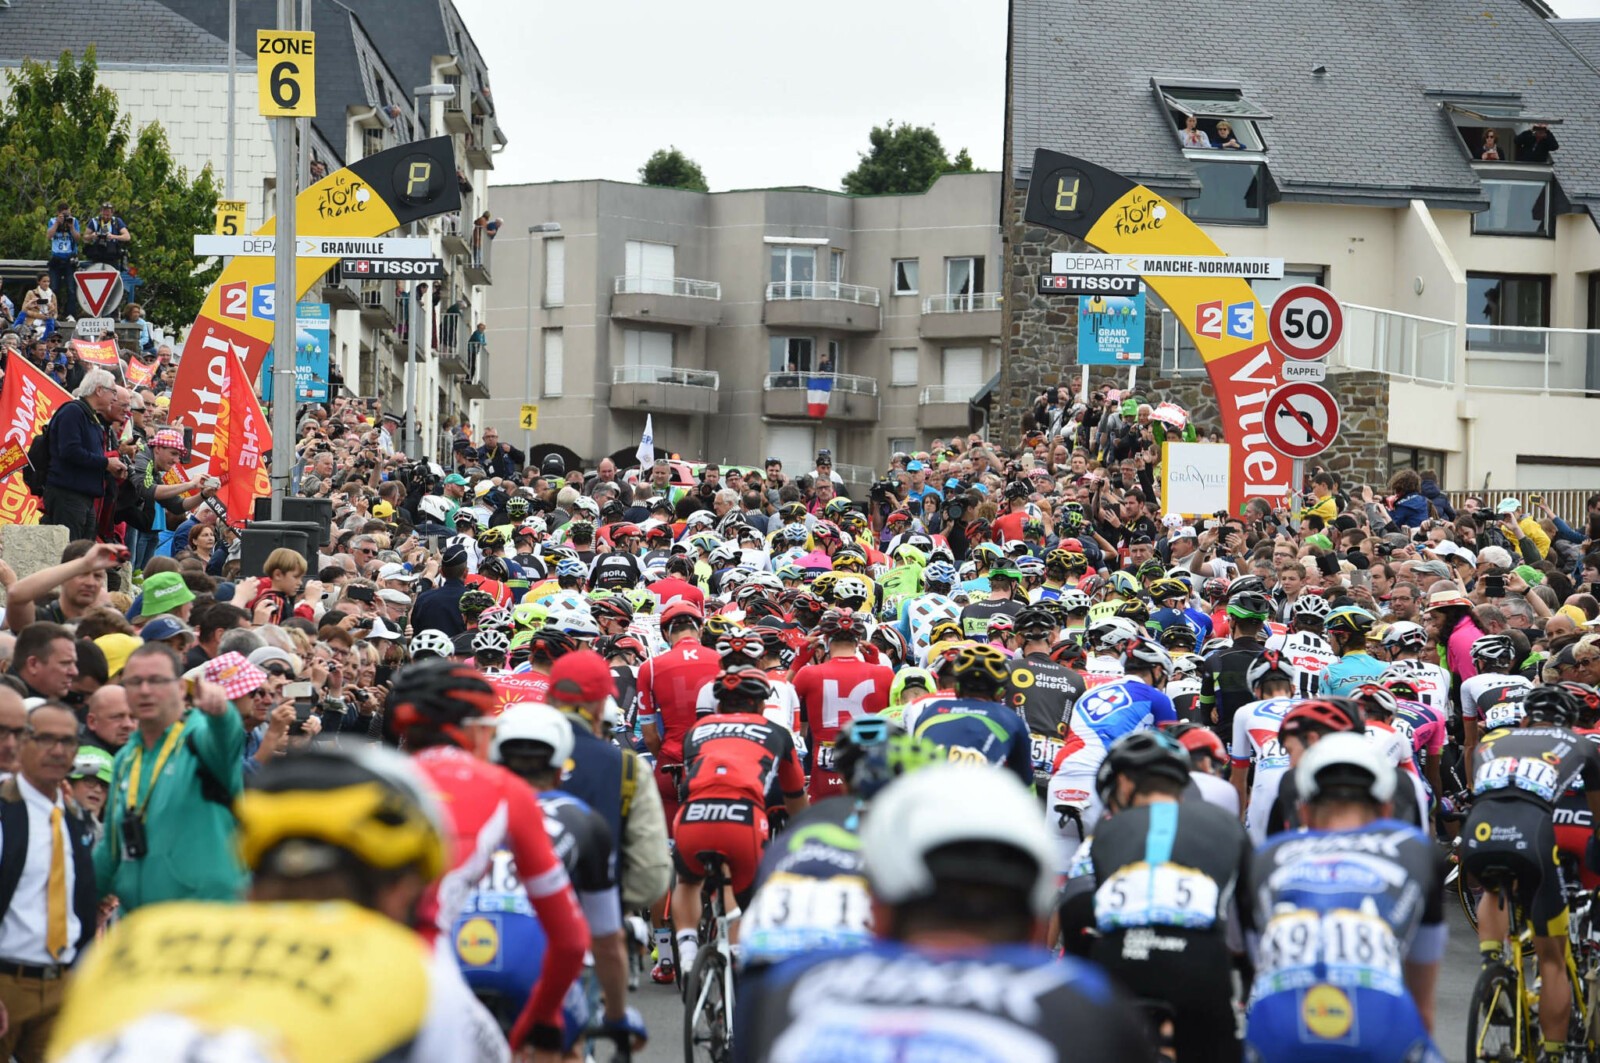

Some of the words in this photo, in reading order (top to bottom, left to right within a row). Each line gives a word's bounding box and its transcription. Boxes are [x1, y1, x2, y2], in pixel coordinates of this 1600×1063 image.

[259, 38, 313, 55] ZONE
[270, 61, 301, 109] 6
[218, 203, 245, 212] ZONE
[222, 215, 238, 236] 5
[321, 242, 384, 254] GRANVILLE
[371, 262, 439, 274] TISSOT
[1066, 256, 1122, 270] DÉPART
[1144, 260, 1270, 274] MANCHE-NORMANDIE
[1068, 276, 1136, 291] TISSOT
[226, 289, 247, 314] 2
[1202, 307, 1222, 333] 2
[1233, 308, 1253, 334] 3
[1284, 308, 1329, 340] 50
[1098, 336, 1130, 344] DÉPART
[1287, 367, 1321, 376] RAPPEL
[523, 414, 533, 426] 4
[1229, 346, 1289, 498] Vittel
[1169, 468, 1226, 485] GRANVILLE
[603, 570, 627, 578] BORA
[1298, 645, 1334, 657] GIANT
[500, 674, 550, 690] Cofidis
[1035, 672, 1068, 684] direct
[1035, 681, 1076, 693] energie
[692, 723, 772, 742] BMC
[685, 803, 749, 821] BMC
[1552, 808, 1593, 825] MC
[1110, 878, 1126, 908] 5
[1176, 878, 1192, 908] 5
